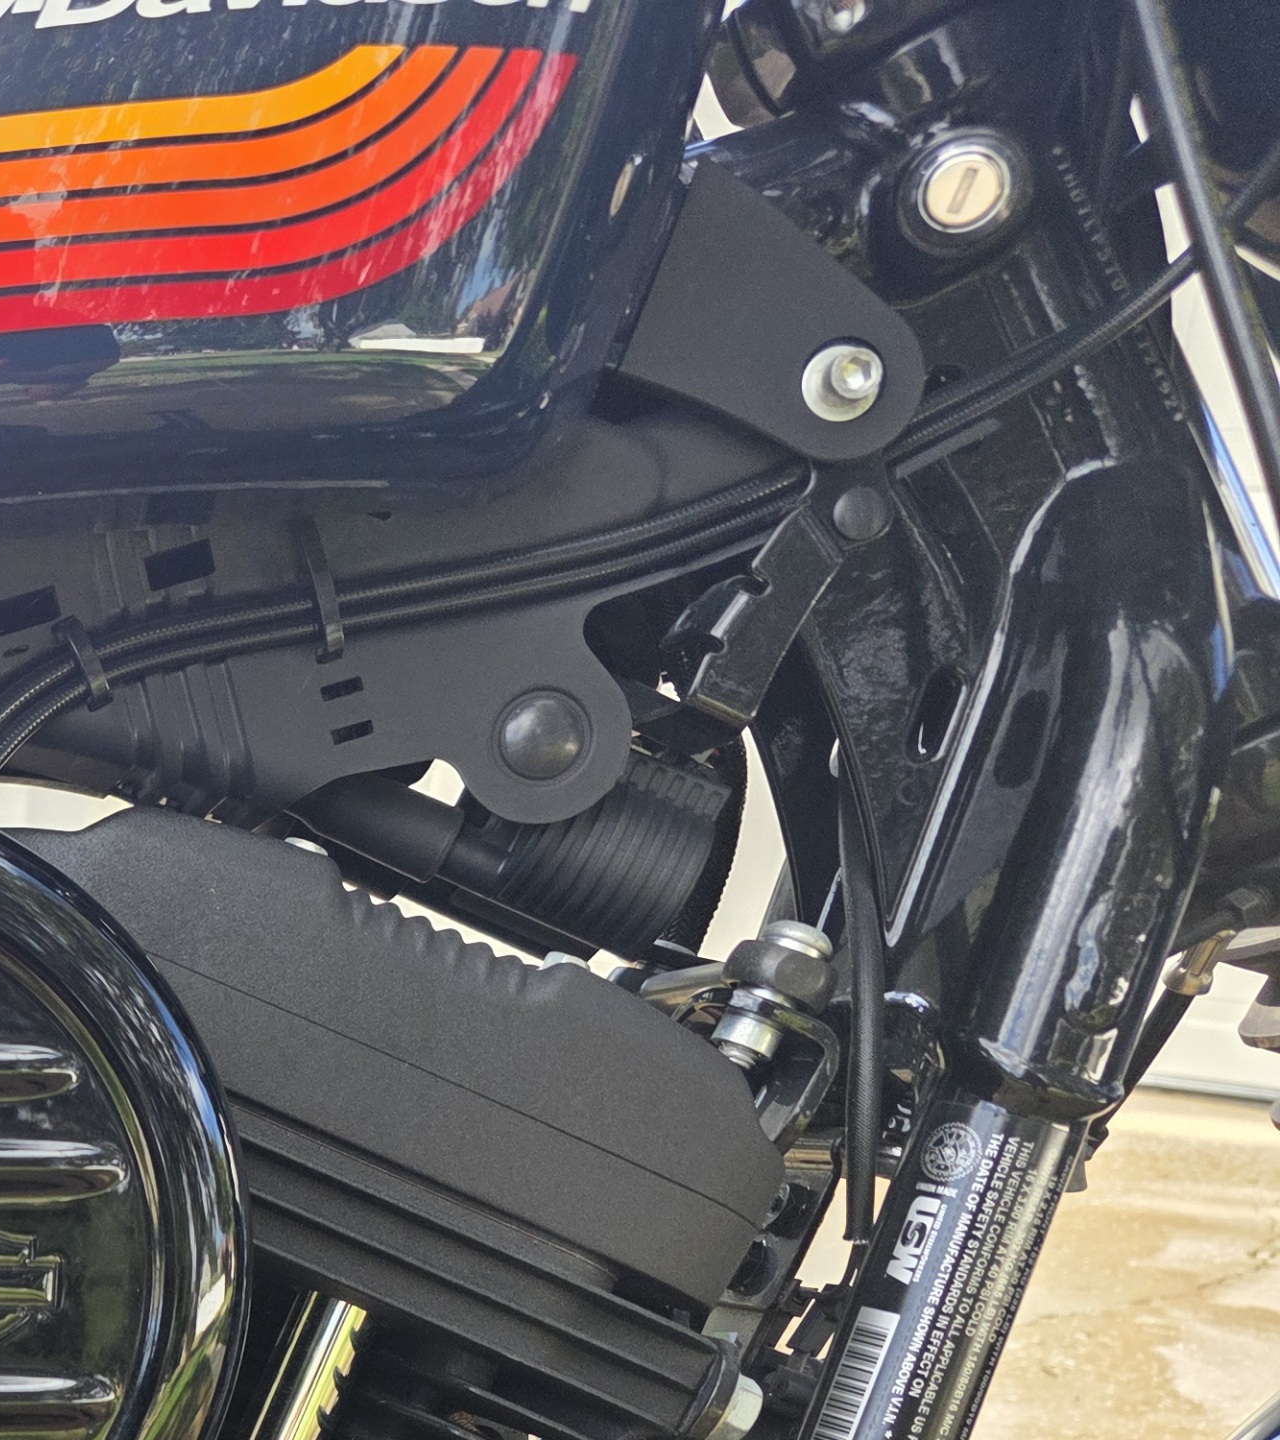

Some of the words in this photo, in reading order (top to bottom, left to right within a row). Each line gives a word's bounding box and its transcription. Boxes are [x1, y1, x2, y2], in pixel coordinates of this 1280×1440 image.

[983, 1130, 1004, 1159] THE
[1013, 1139, 1035, 1170] THIS
[970, 1157, 993, 1193] DATE
[989, 1134, 1021, 1190] VEHICLE
[963, 1191, 980, 1211] OF
[992, 1168, 1023, 1223] VEHICLE
[1019, 1183, 1031, 1194] X
[970, 1188, 999, 1238] SAFETY
[1009, 1194, 1027, 1220] 3.00
[886, 1195, 941, 1285] USW
[1000, 1220, 1017, 1244] RIM
[1022, 1226, 1038, 1250] RIM
[925, 1211, 973, 1305] MANUFACTURE
[964, 1223, 1002, 1295] CONFORMS
[993, 1244, 1008, 1262] AT
[1016, 1251, 1028, 1268] AT
[939, 1238, 980, 1314] STANDARDS
[986, 1262, 1000, 1279] 40
[956, 1294, 973, 1315] TO
[978, 1279, 994, 1301] PSI
[1001, 1286, 1015, 1306] PSI
[907, 1304, 936, 1353] SHOWN
[934, 1313, 950, 1330] IN
[946, 1313, 966, 1341] ALL
[963, 1300, 986, 1338] COLD
[986, 1306, 1007, 1343] COLD
[970, 1320, 992, 1353] WITH
[915, 1328, 945, 1378] EFFECT
[890, 1351, 918, 1396] ABOVE
[907, 1376, 926, 1399] ON
[916, 1339, 957, 1416] APPLICABLE
[880, 1394, 904, 1428] V.I.N.
[909, 1414, 926, 1435] US
[939, 1413, 956, 1436] M/C
